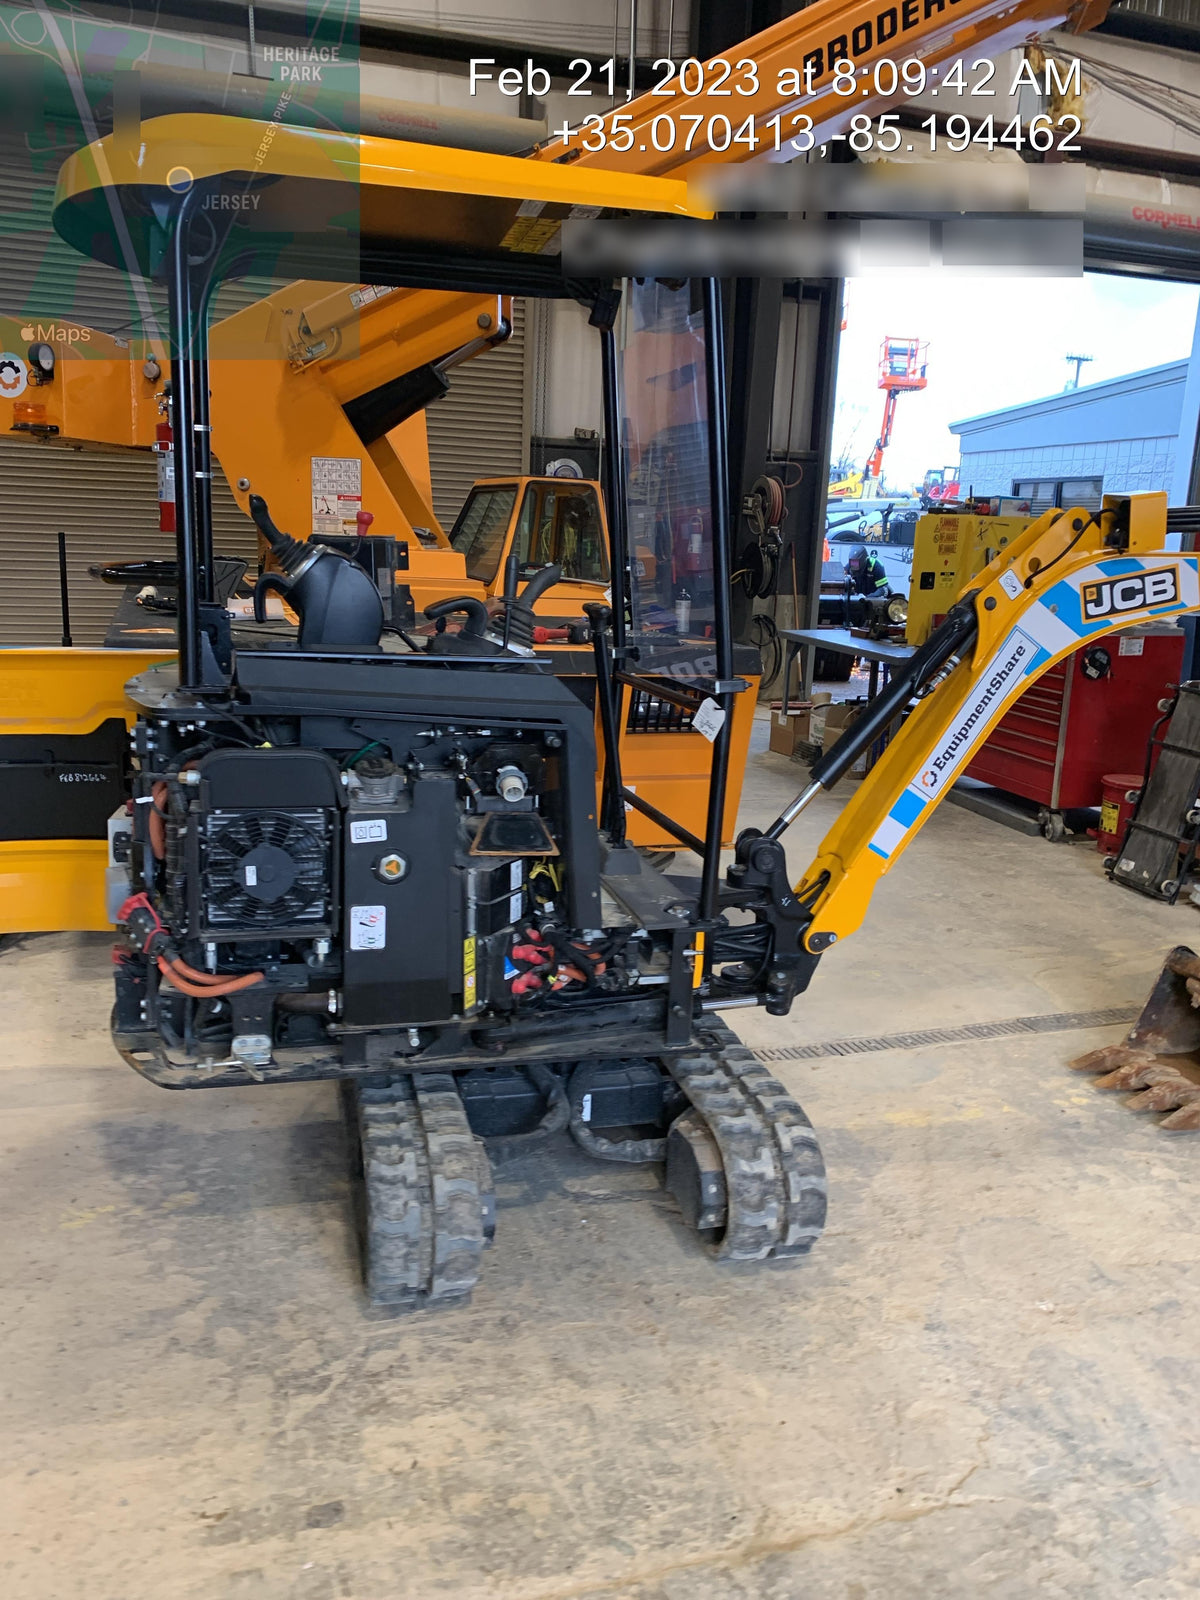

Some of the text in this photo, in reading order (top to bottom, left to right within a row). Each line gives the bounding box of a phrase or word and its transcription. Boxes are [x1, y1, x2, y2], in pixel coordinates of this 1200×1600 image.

[803, 0, 961, 84] BRODER
[1086, 571, 1176, 616] JCB
[932, 645, 1027, 771] EquipmentShare
